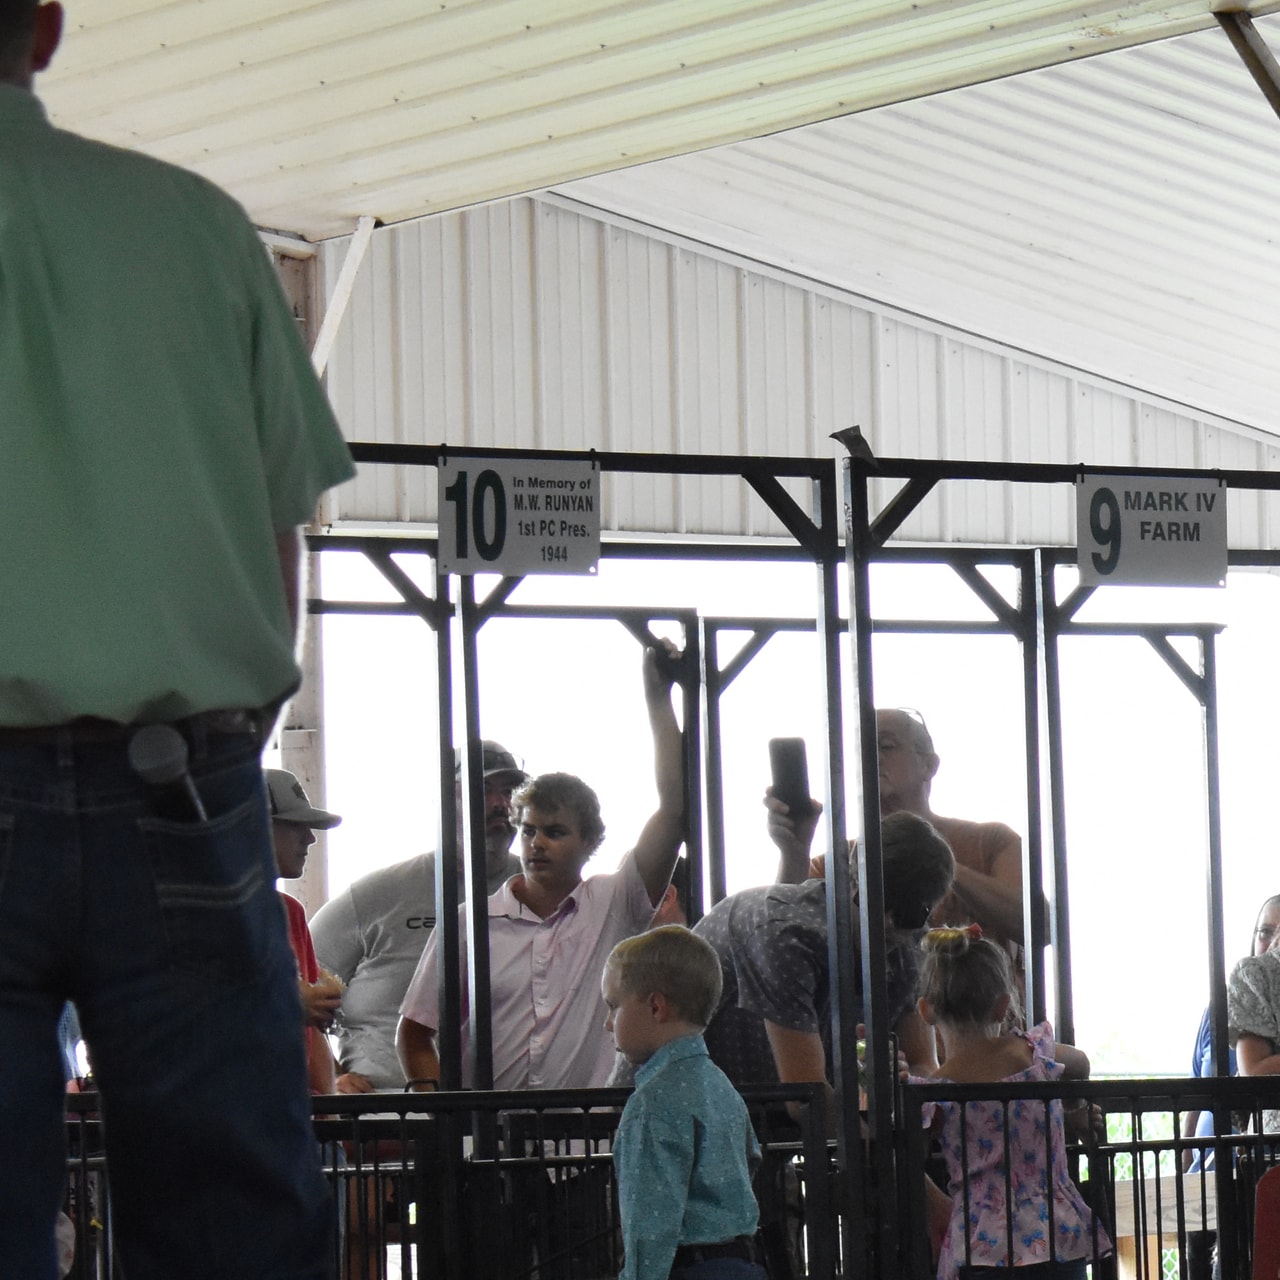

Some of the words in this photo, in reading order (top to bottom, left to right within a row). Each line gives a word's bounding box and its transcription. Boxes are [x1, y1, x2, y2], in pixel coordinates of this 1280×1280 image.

[513, 477, 524, 488] In
[528, 477, 576, 492] Memory
[580, 478, 591, 489] of
[514, 494, 541, 511] M.W.
[545, 495, 593, 512] RUNYAN
[1124, 491, 1188, 511] MARK
[1196, 492, 1216, 512] IV
[445, 469, 507, 561] 10
[518, 520, 535, 536] 1st
[540, 520, 555, 536] PC
[560, 521, 590, 537] Pres.
[1089, 487, 1122, 576] 9
[1140, 521, 1200, 542] FARM
[541, 546, 568, 562] 1944
